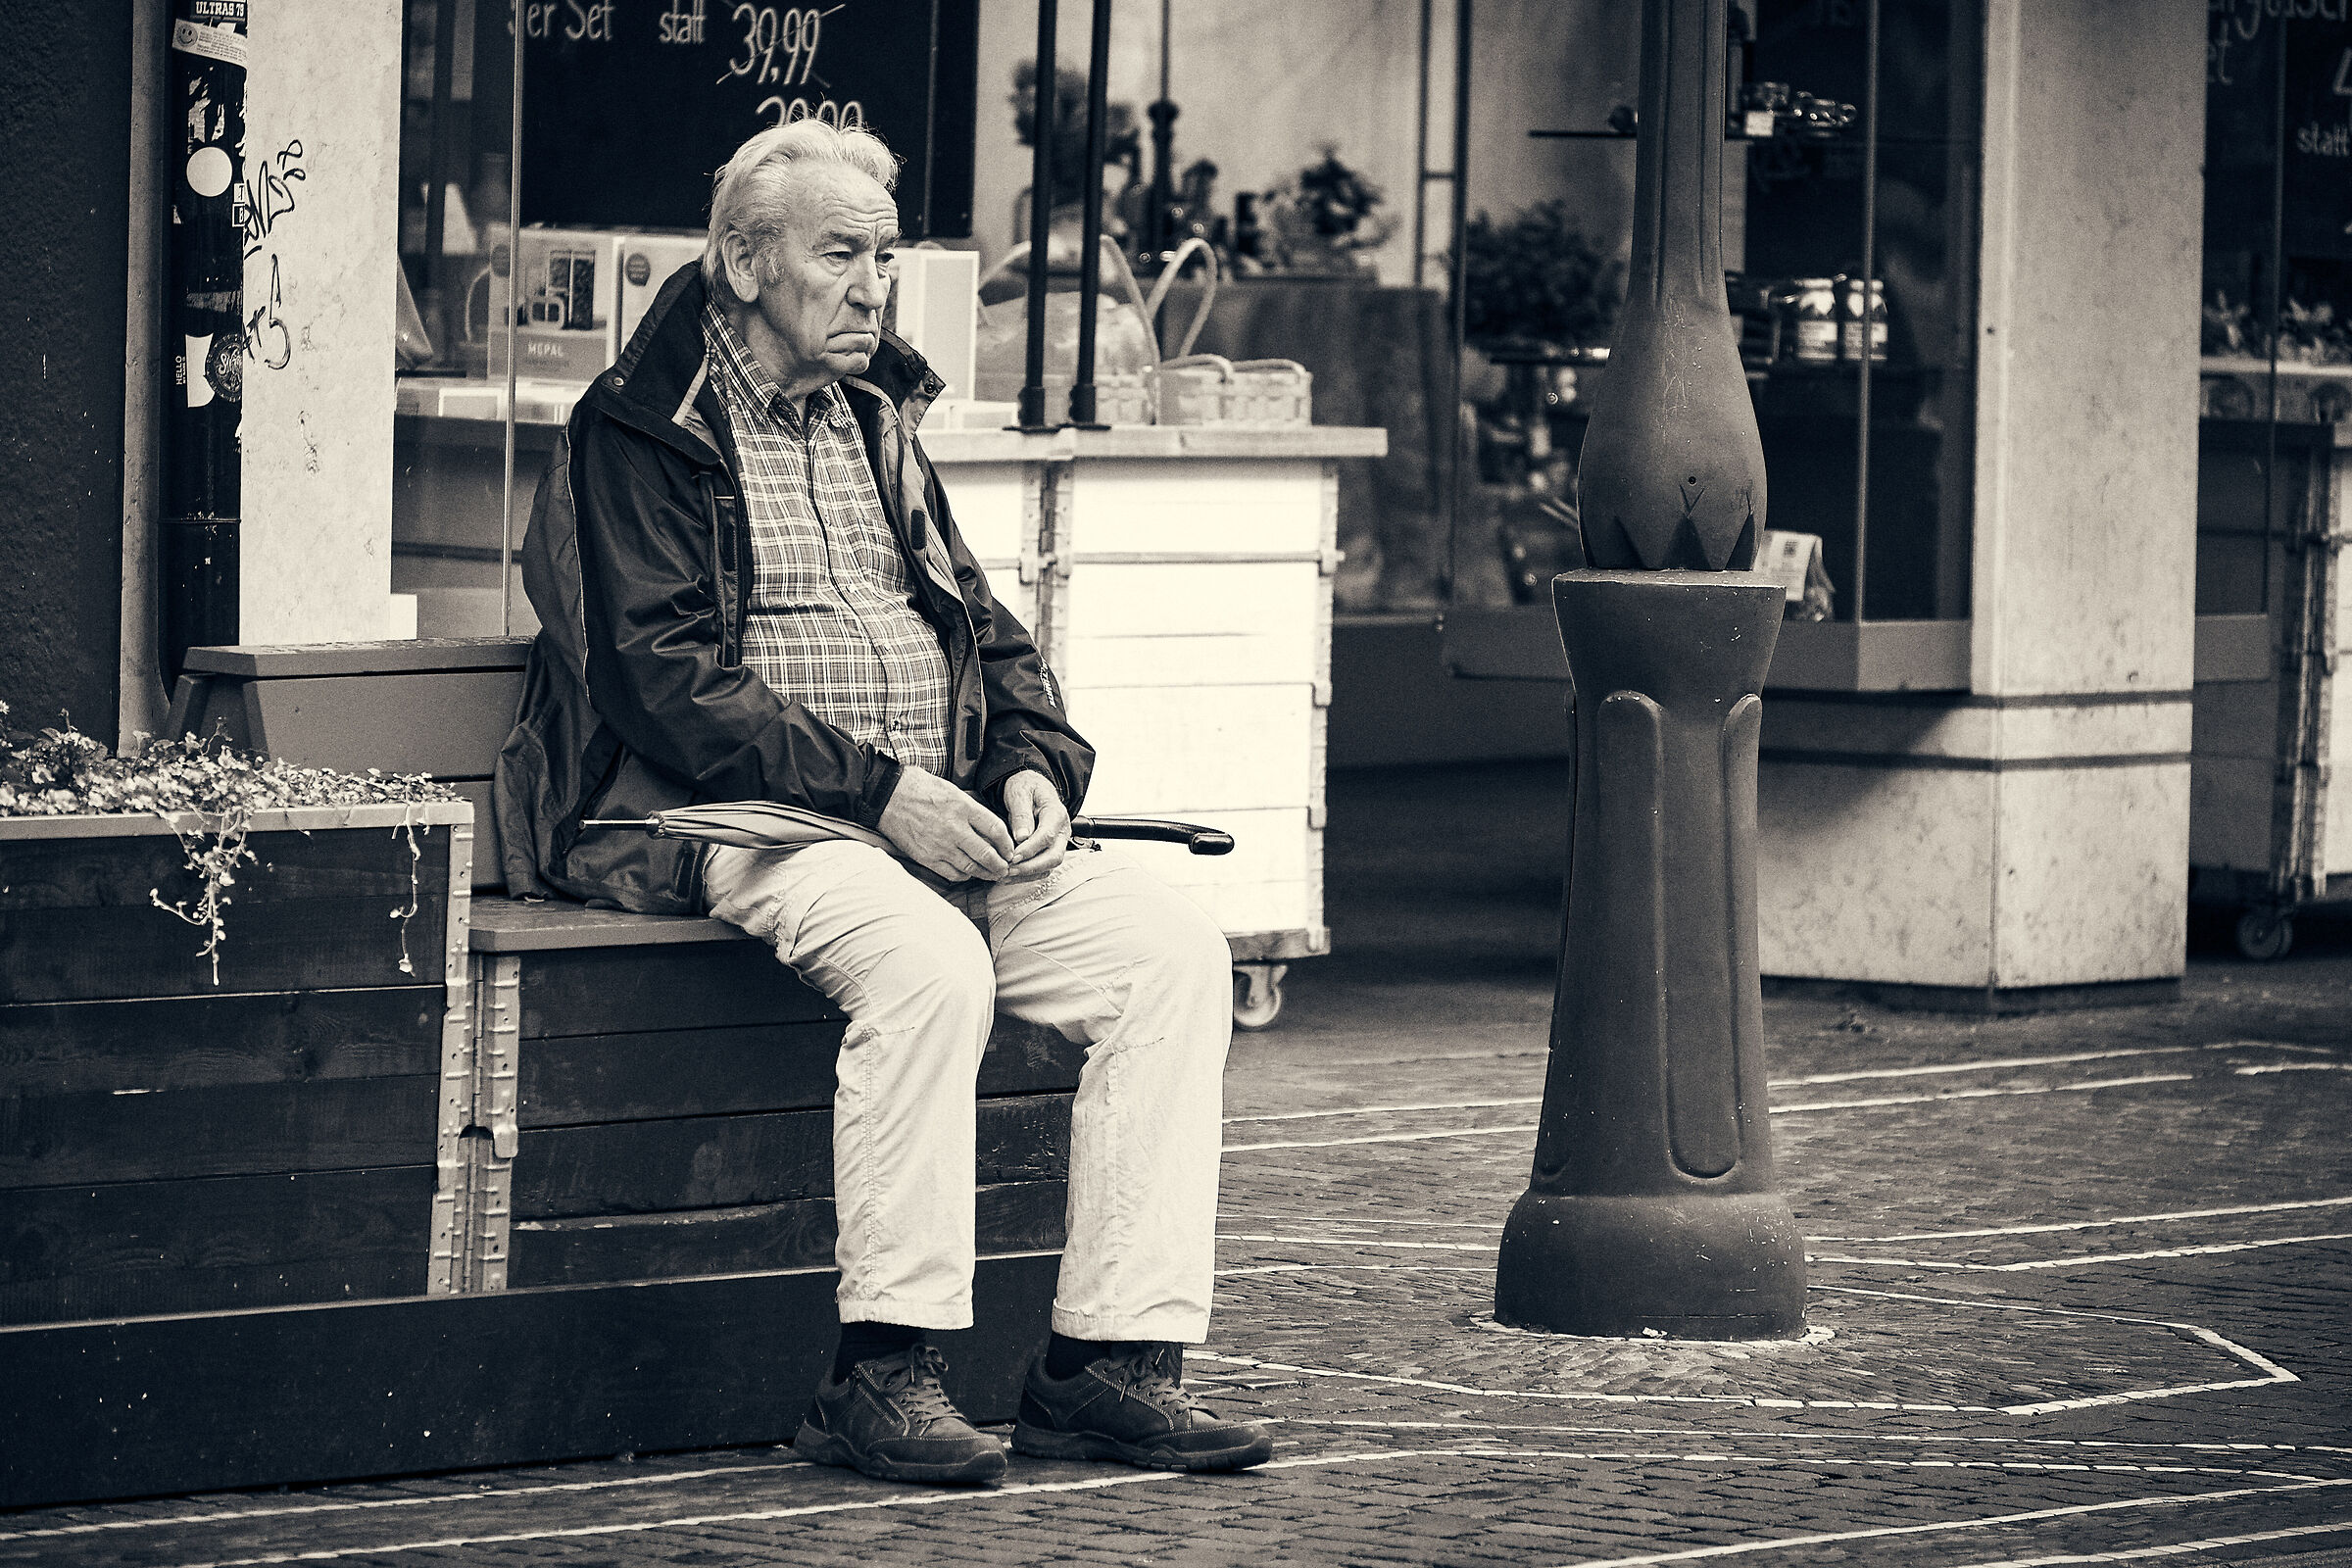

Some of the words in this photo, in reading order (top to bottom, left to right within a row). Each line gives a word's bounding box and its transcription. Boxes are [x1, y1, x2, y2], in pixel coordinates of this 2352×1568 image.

[196, 1, 234, 16] ULTRAS
[659, 0, 707, 44] statt
[729, 3, 820, 85] 39,99
[2297, 121, 2349, 157] statt
